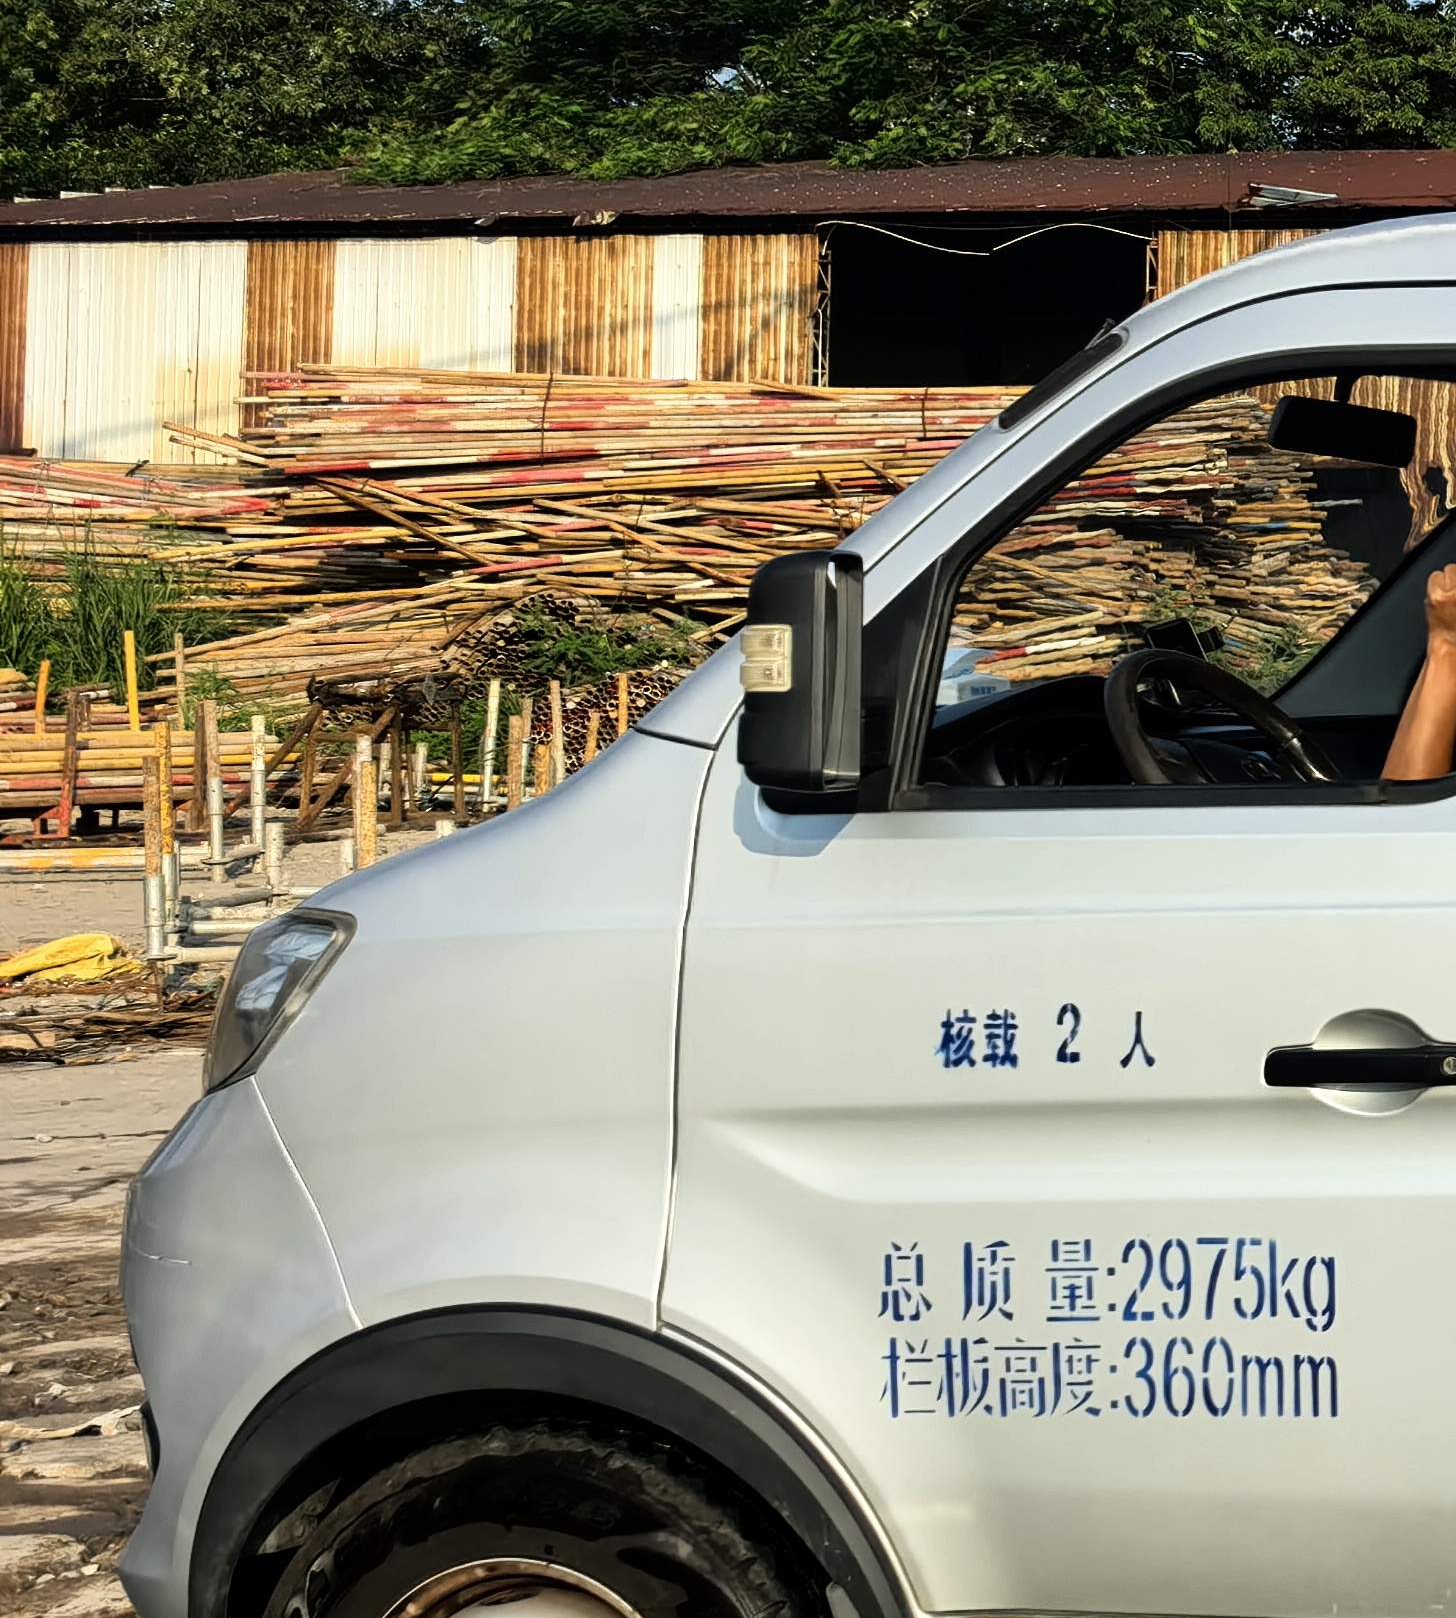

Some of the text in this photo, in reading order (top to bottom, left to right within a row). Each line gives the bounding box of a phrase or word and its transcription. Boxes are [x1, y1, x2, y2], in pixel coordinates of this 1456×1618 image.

[935, 1003, 1155, 1068] 核载 2 人
